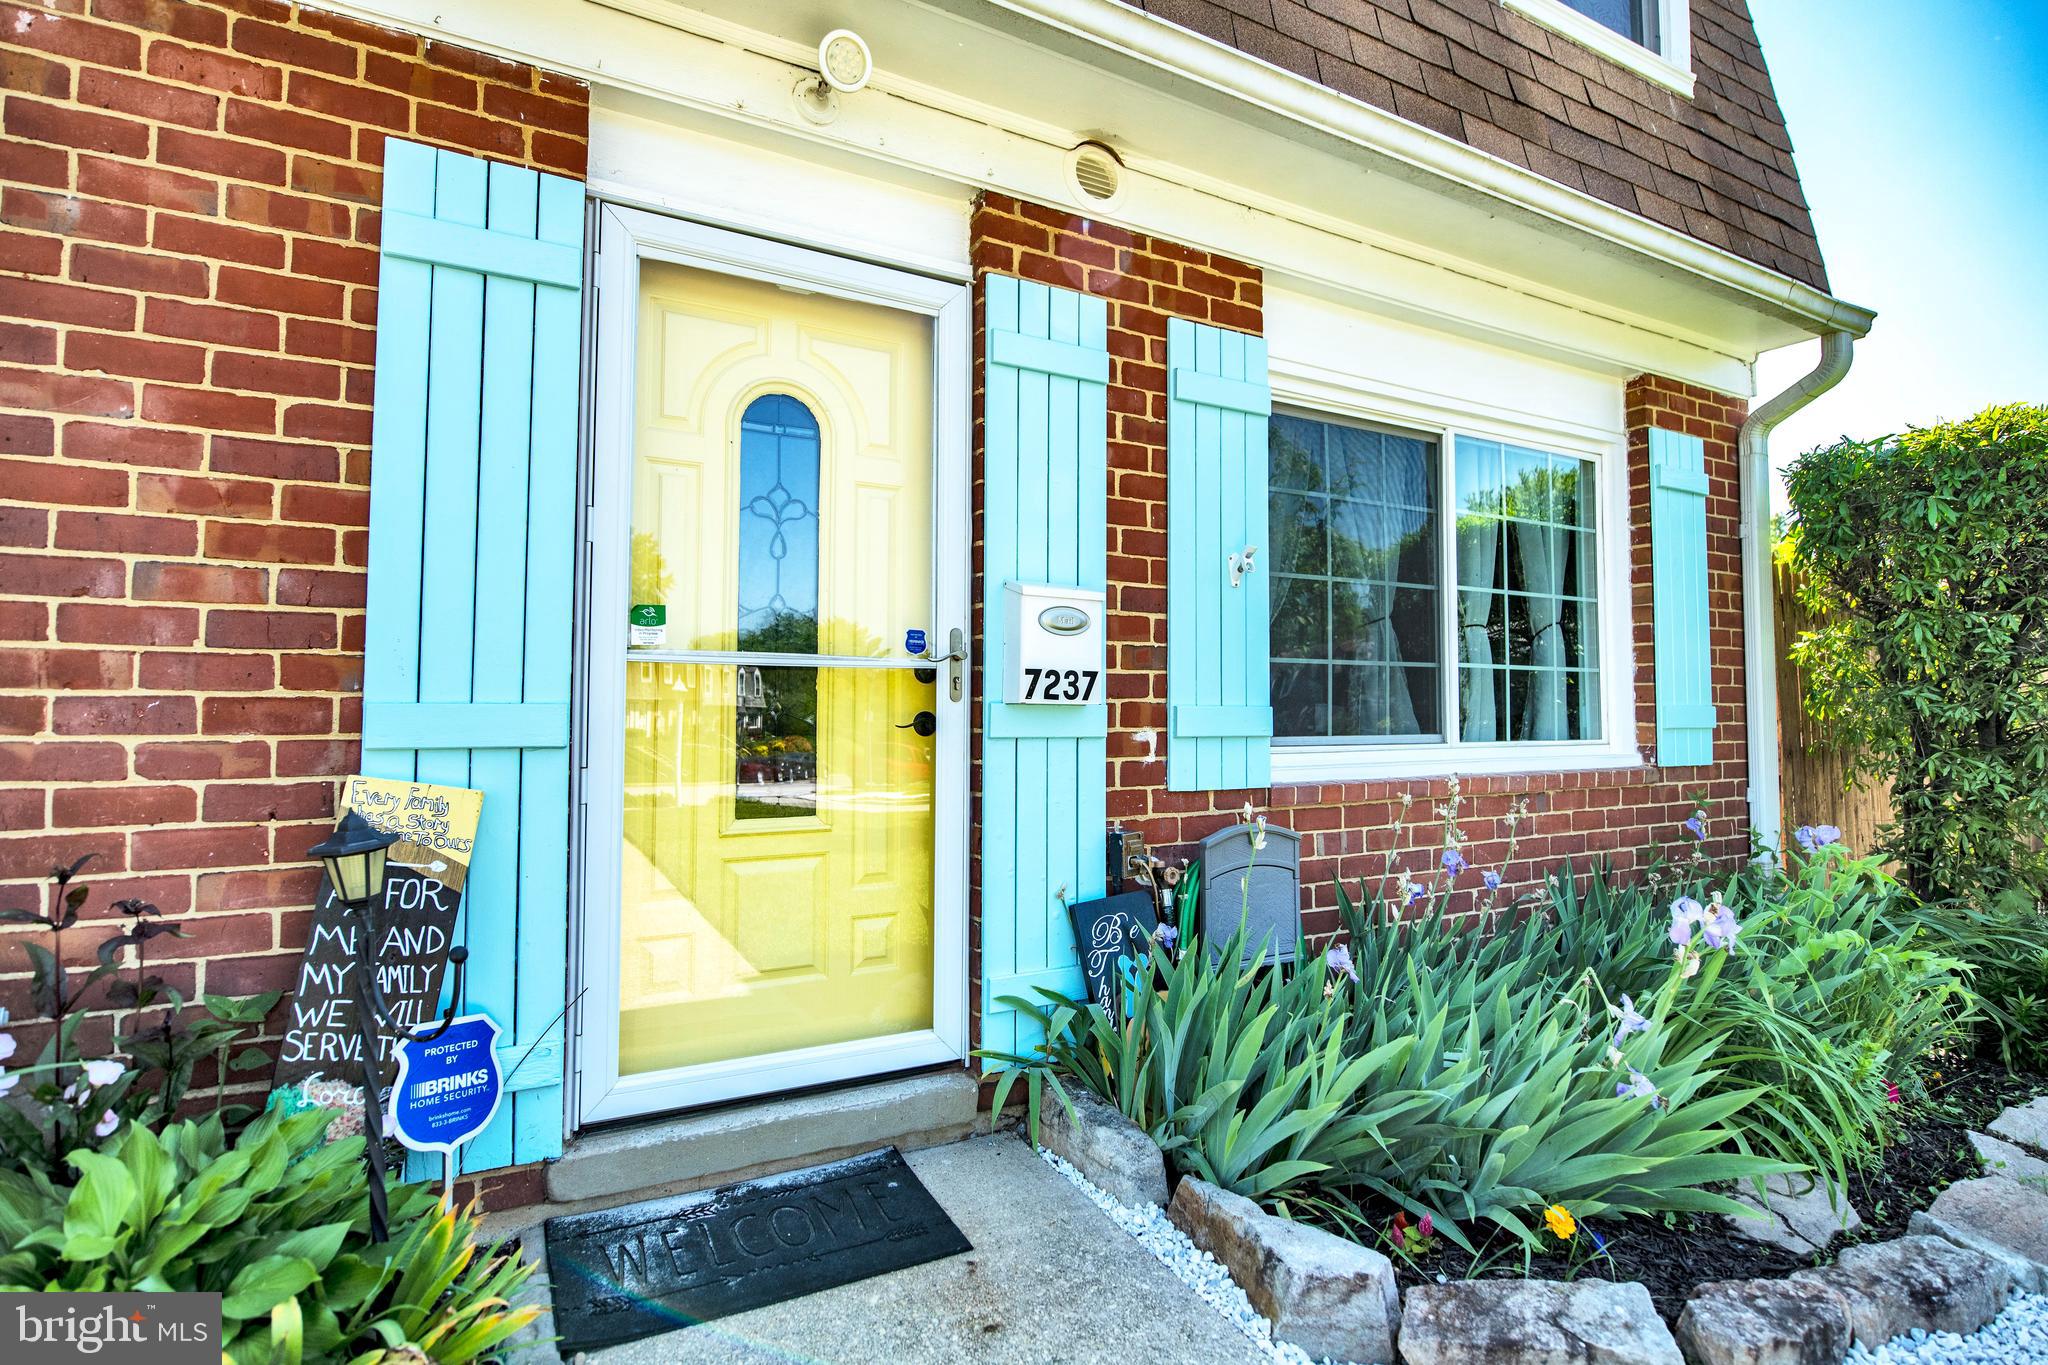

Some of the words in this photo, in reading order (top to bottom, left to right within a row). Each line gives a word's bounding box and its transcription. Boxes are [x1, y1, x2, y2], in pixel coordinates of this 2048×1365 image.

[639, 617, 657, 625] arlo
[1024, 668, 1099, 701] 7237
[351, 780, 400, 815] Every
[403, 787, 450, 818] Family
[406, 814, 450, 835] Story
[414, 831, 433, 847] To
[434, 834, 472, 853] Ours
[385, 878, 449, 912] FOR
[379, 925, 445, 957] AND
[1091, 912, 1140, 948] Be
[299, 962, 356, 997] MY
[375, 962, 438, 994] AMILY
[294, 1000, 354, 1028] WE
[424, 1039, 479, 1057] PROTECTED
[446, 1055, 459, 1065] BY
[425, 1068, 489, 1097] BRINKS
[410, 1096, 441, 1110] HOME
[443, 1084, 489, 1102] SECURITY
[428, 1107, 472, 1122] brinkshome.com
[600, 1181, 906, 1285] WELCOME
